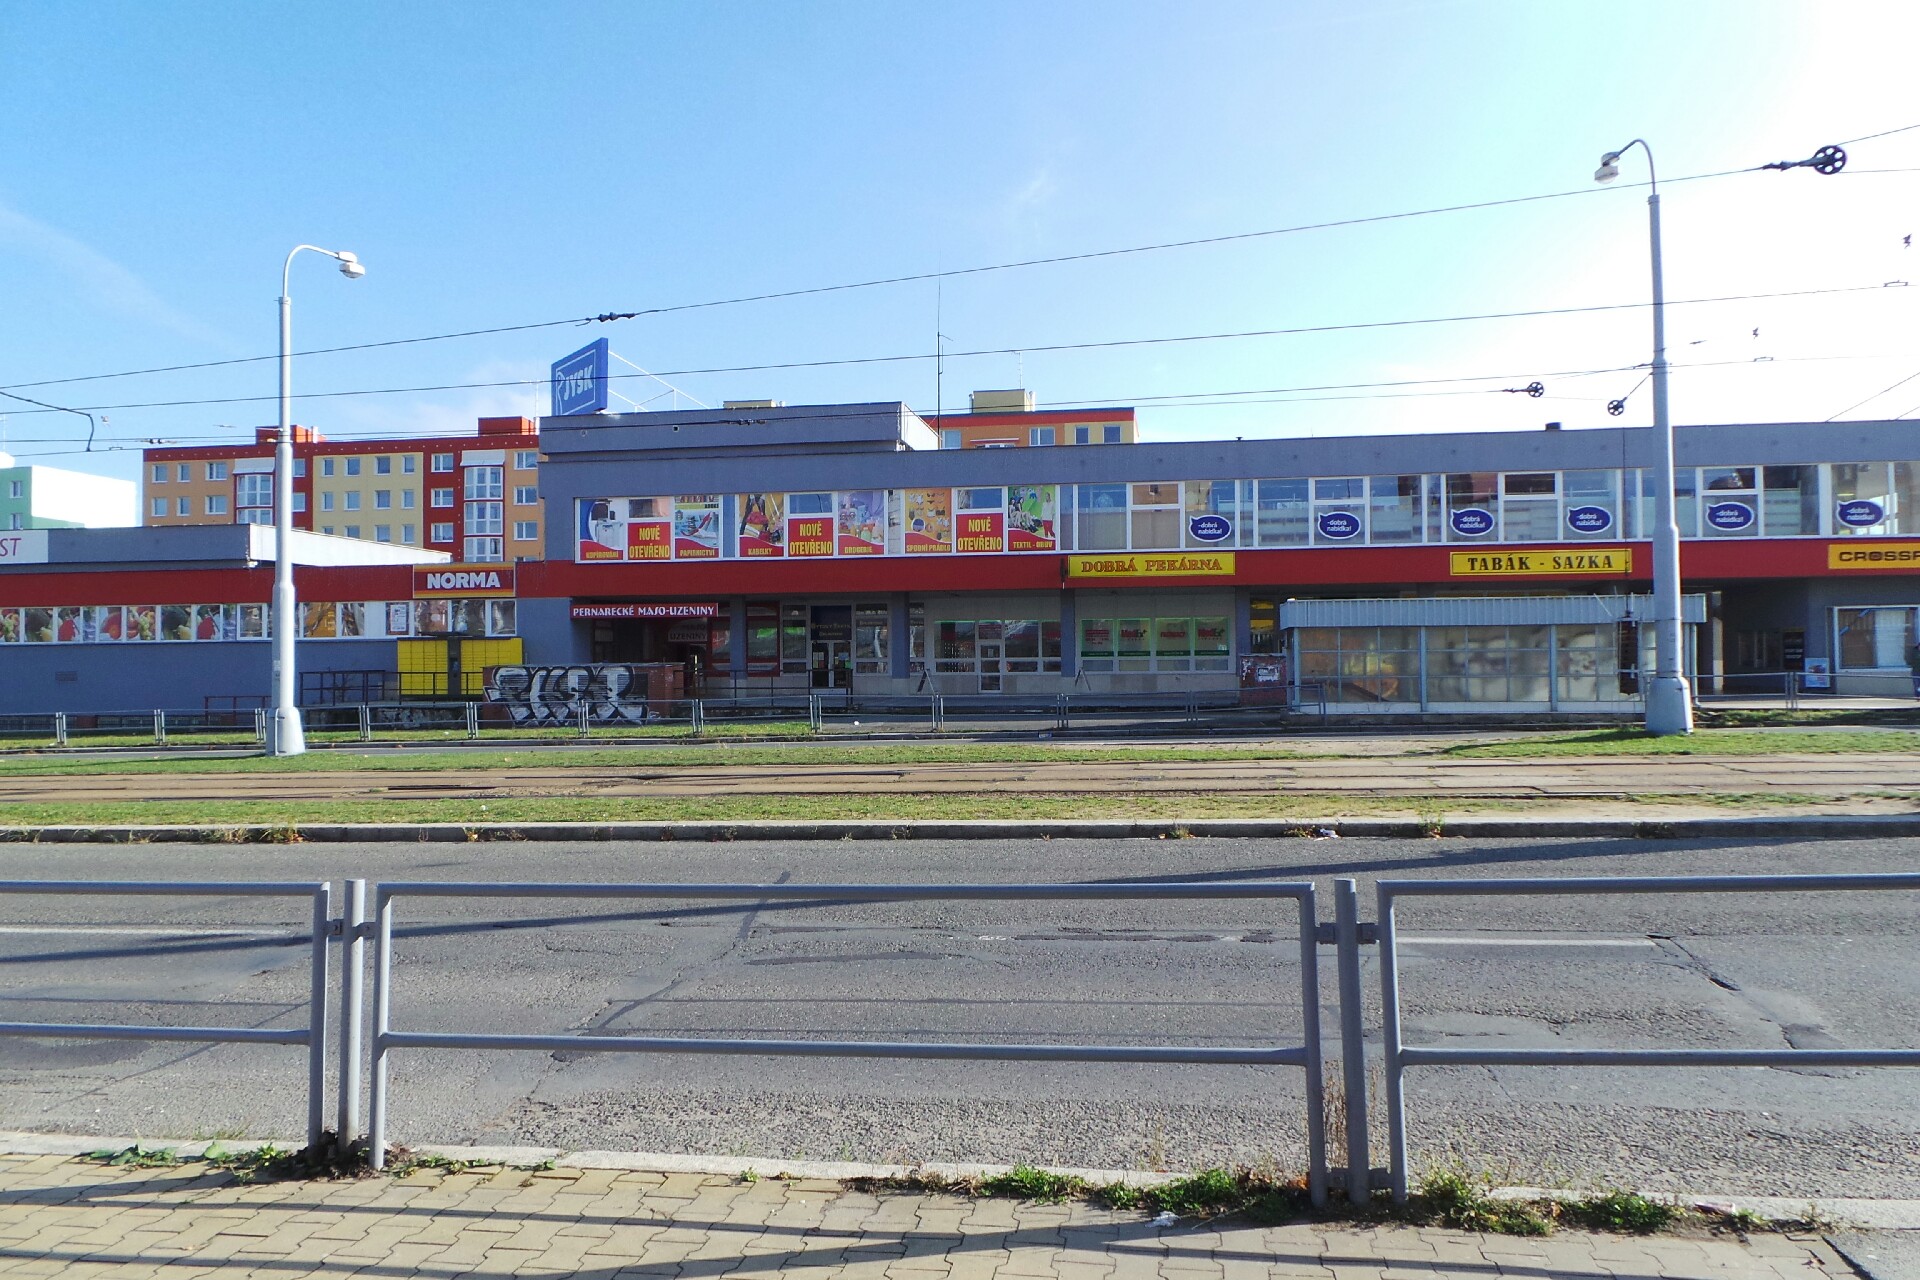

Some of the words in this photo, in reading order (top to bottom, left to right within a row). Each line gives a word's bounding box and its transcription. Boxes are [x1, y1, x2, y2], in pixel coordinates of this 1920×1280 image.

[564, 364, 593, 401] JYSK
[629, 543, 670, 558] OTEVŘENO
[789, 539, 833, 555] OTEVŘENO
[957, 535, 1002, 551] OTEVŘENO
[1013, 541, 1032, 549] TEXTIL
[1081, 557, 1138, 573] DOBRÁ
[1145, 556, 1222, 572] PEKÁRNA
[1467, 553, 1531, 571] TABÁK
[1552, 555, 1613, 570] SAZKA
[427, 571, 501, 589] NORMA
[573, 604, 635, 617] PERNARECKÉ
